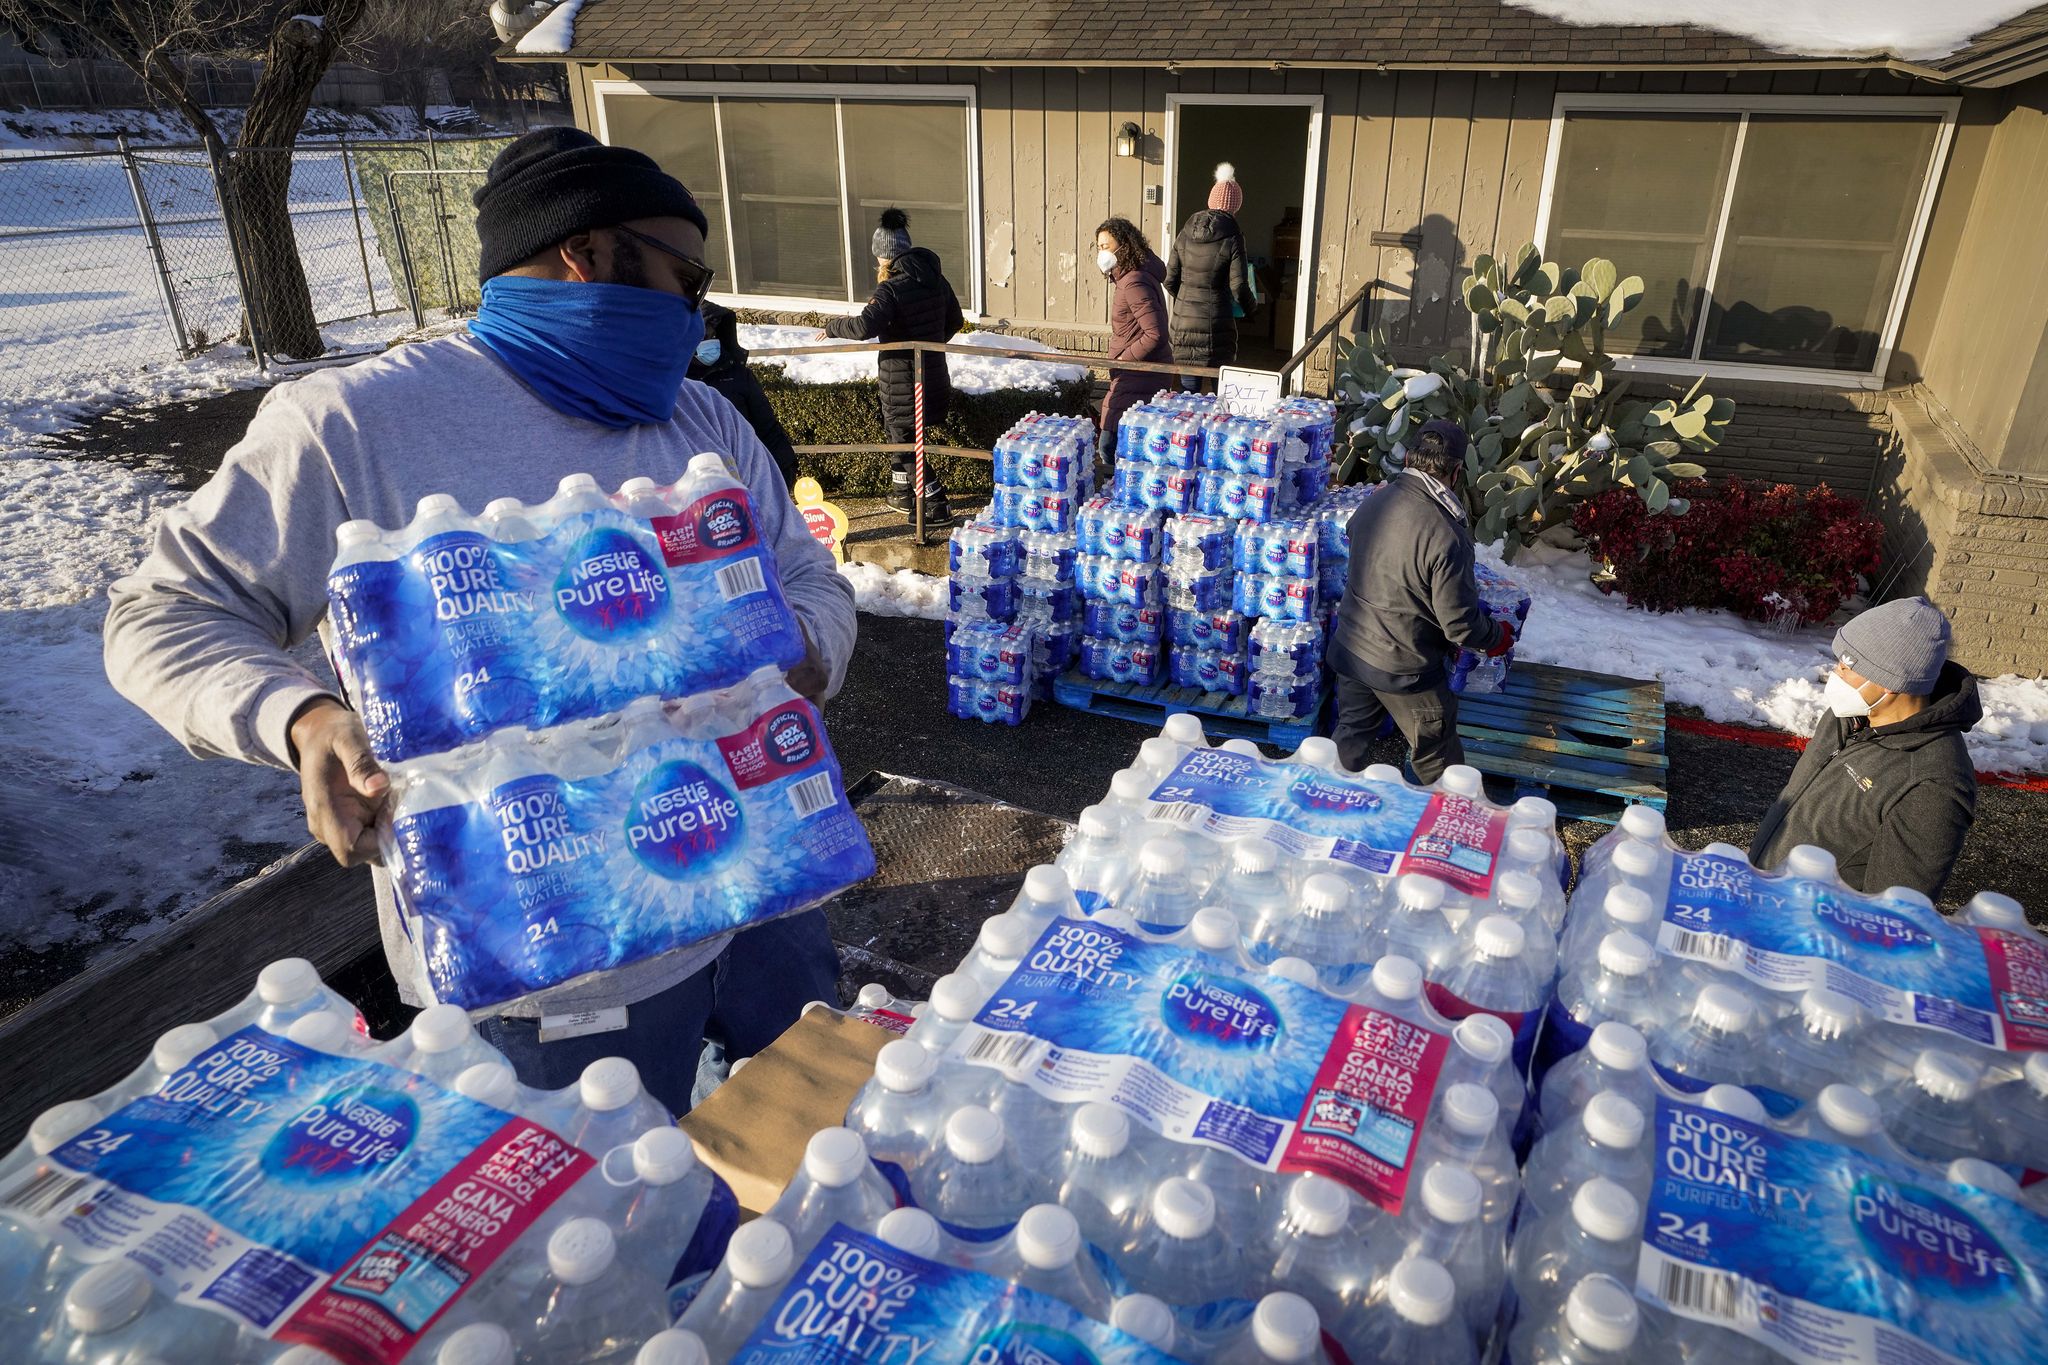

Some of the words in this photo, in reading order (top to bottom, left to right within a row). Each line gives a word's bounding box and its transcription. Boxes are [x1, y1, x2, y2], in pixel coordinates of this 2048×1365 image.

[1224, 384, 1269, 401] EXIT
[705, 501, 734, 518] OFFICIAL
[707, 511, 735, 530] BOX
[803, 513, 826, 524] Slow
[662, 523, 694, 538] EARN
[664, 531, 695, 545] CASH
[713, 519, 741, 534] TOPS
[717, 535, 742, 547] BRAND
[424, 546, 496, 575] 100%
[667, 543, 698, 553] SCHOOL
[430, 569, 504, 599] PURE
[557, 577, 625, 611] Pure
[627, 569, 667, 602] Life
[437, 591, 535, 620] QUALITY
[458, 666, 491, 693] 24
[769, 713, 799, 732] OFFICIAL
[774, 724, 801, 746] BOX
[728, 737, 760, 759] EARN
[781, 731, 808, 749] TOPS
[732, 748, 762, 766] CASH
[737, 760, 768, 776] SCHOOL
[786, 749, 810, 763] BRAND
[1190, 756, 1245, 777] PURE
[1201, 751, 1252, 771] 100%
[1182, 764, 1271, 788] QUALITY
[1161, 786, 1195, 797] 24
[1291, 782, 1341, 802] Pure
[495, 792, 565, 828] 100%
[628, 811, 698, 849] Pure
[698, 797, 739, 832] Life
[1437, 815, 1487, 835] GANA
[502, 815, 573, 852] PURE
[507, 831, 608, 874] QUALITY
[1681, 863, 1753, 892] PURE
[1686, 857, 1753, 880] 100%
[1679, 873, 1786, 908] QUALITY
[1674, 904, 1712, 922] 24
[1817, 902, 1879, 933] Pure
[527, 916, 559, 944] 24
[1058, 925, 1124, 955] 100%
[1044, 935, 1119, 971] PURE
[1016, 974, 1078, 992] PURIFIED
[1030, 951, 1143, 991] QUALITY
[990, 998, 1039, 1020] 24
[1167, 983, 1229, 1021] Pure
[1231, 1012, 1277, 1037] Life
[1362, 1019, 1426, 1054] CASH
[1366, 1011, 1431, 1043] EARN
[226, 1038, 289, 1077] 100%
[1353, 1037, 1419, 1071] SCHOOL
[1356, 1030, 1385, 1044] FOR
[1387, 1040, 1421, 1060] YOUR
[197, 1051, 268, 1096] PURE
[1342, 1063, 1412, 1095] DINERO
[1347, 1052, 1413, 1086] GANA
[158, 1071, 276, 1123] QUALITY
[1333, 1080, 1404, 1113] ESCUELA
[1338, 1073, 1380, 1094] PARA
[1387, 1090, 1407, 1102] TU
[77, 1130, 134, 1155] 24
[288, 1104, 357, 1148] Pure
[347, 1134, 398, 1165] Life
[519, 1127, 579, 1167] EARN
[1322, 1138, 1338, 1149] NO
[1668, 1109, 1767, 1158] 100%
[502, 1140, 564, 1180] CASH
[1669, 1122, 1768, 1180] PURE
[476, 1163, 536, 1202] SCHOOL
[515, 1162, 547, 1189] YOUR
[1667, 1146, 1814, 1212] QUALITY
[452, 1182, 516, 1224] GANA
[1665, 1181, 1742, 1210] PURIFIED
[421, 1213, 458, 1239] PARA
[461, 1231, 485, 1249] TU
[434, 1197, 500, 1236] DINERO
[1657, 1212, 1712, 1246] 24
[1854, 1195, 1940, 1252] Pure
[1947, 1237, 2015, 1277] Life
[830, 1241, 919, 1299] 100%
[806, 1259, 906, 1332] PURE
[775, 1288, 938, 1365] QUALITY
